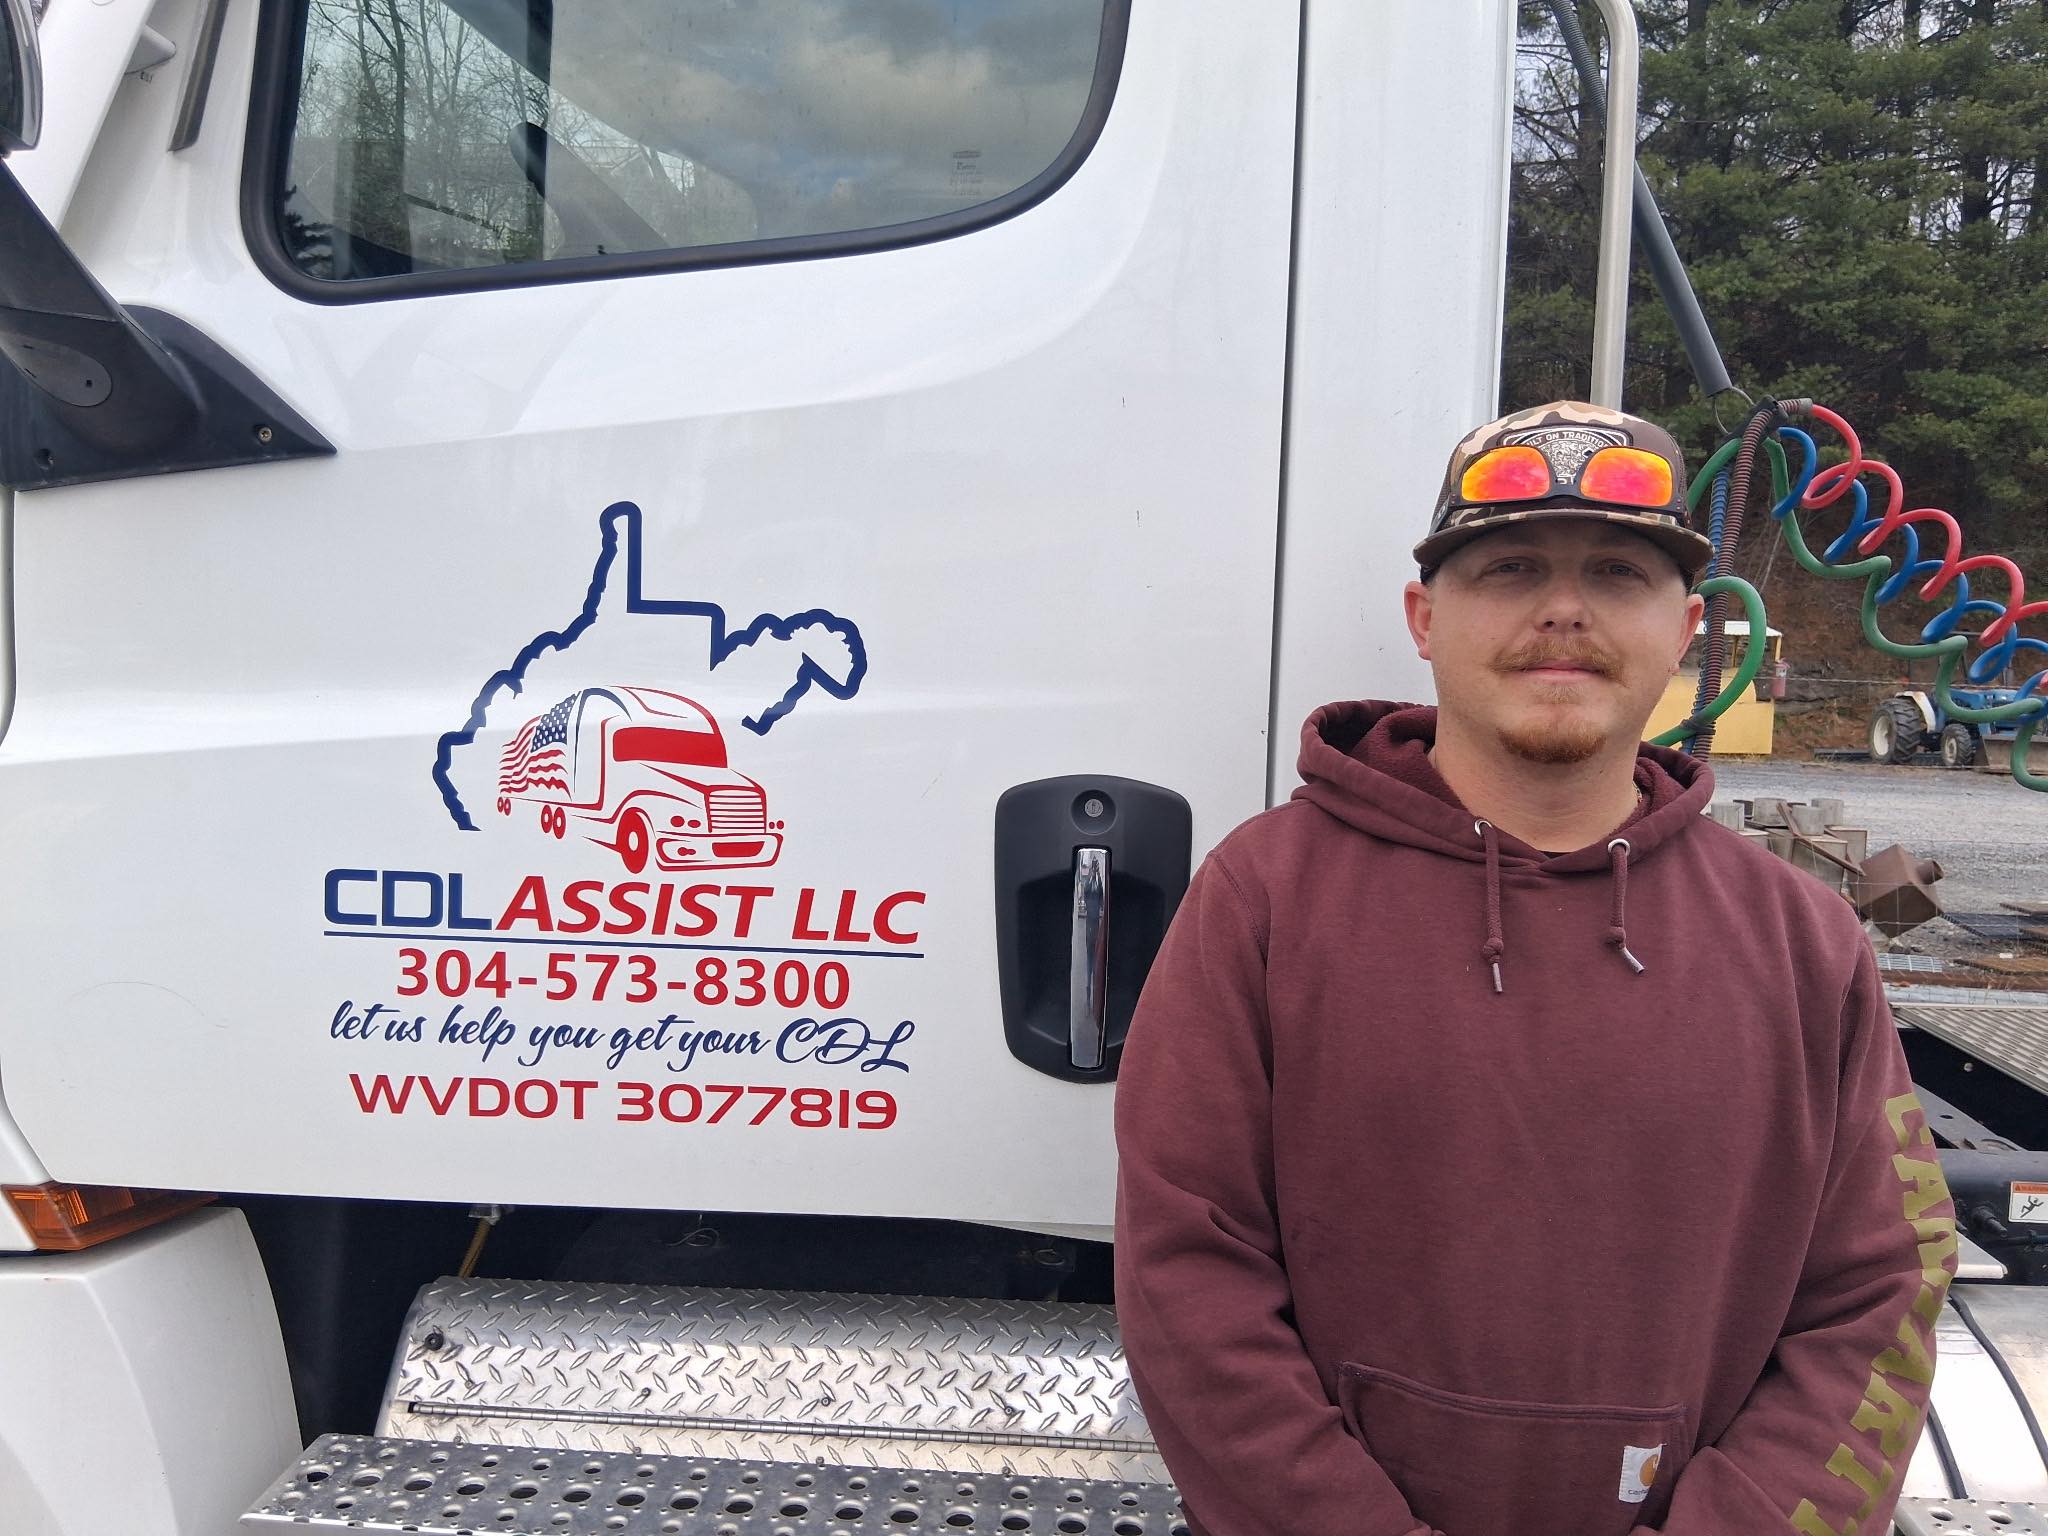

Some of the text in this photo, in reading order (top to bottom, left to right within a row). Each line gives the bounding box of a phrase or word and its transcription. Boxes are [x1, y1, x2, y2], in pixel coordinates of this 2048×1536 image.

[1546, 431, 1560, 441] ON
[791, 887, 926, 945] LLC
[396, 947, 850, 1010] 304-573-8300
[330, 1000, 915, 1073] let us help you get your CDL
[349, 1073, 899, 1131] WVDOT 3077819
